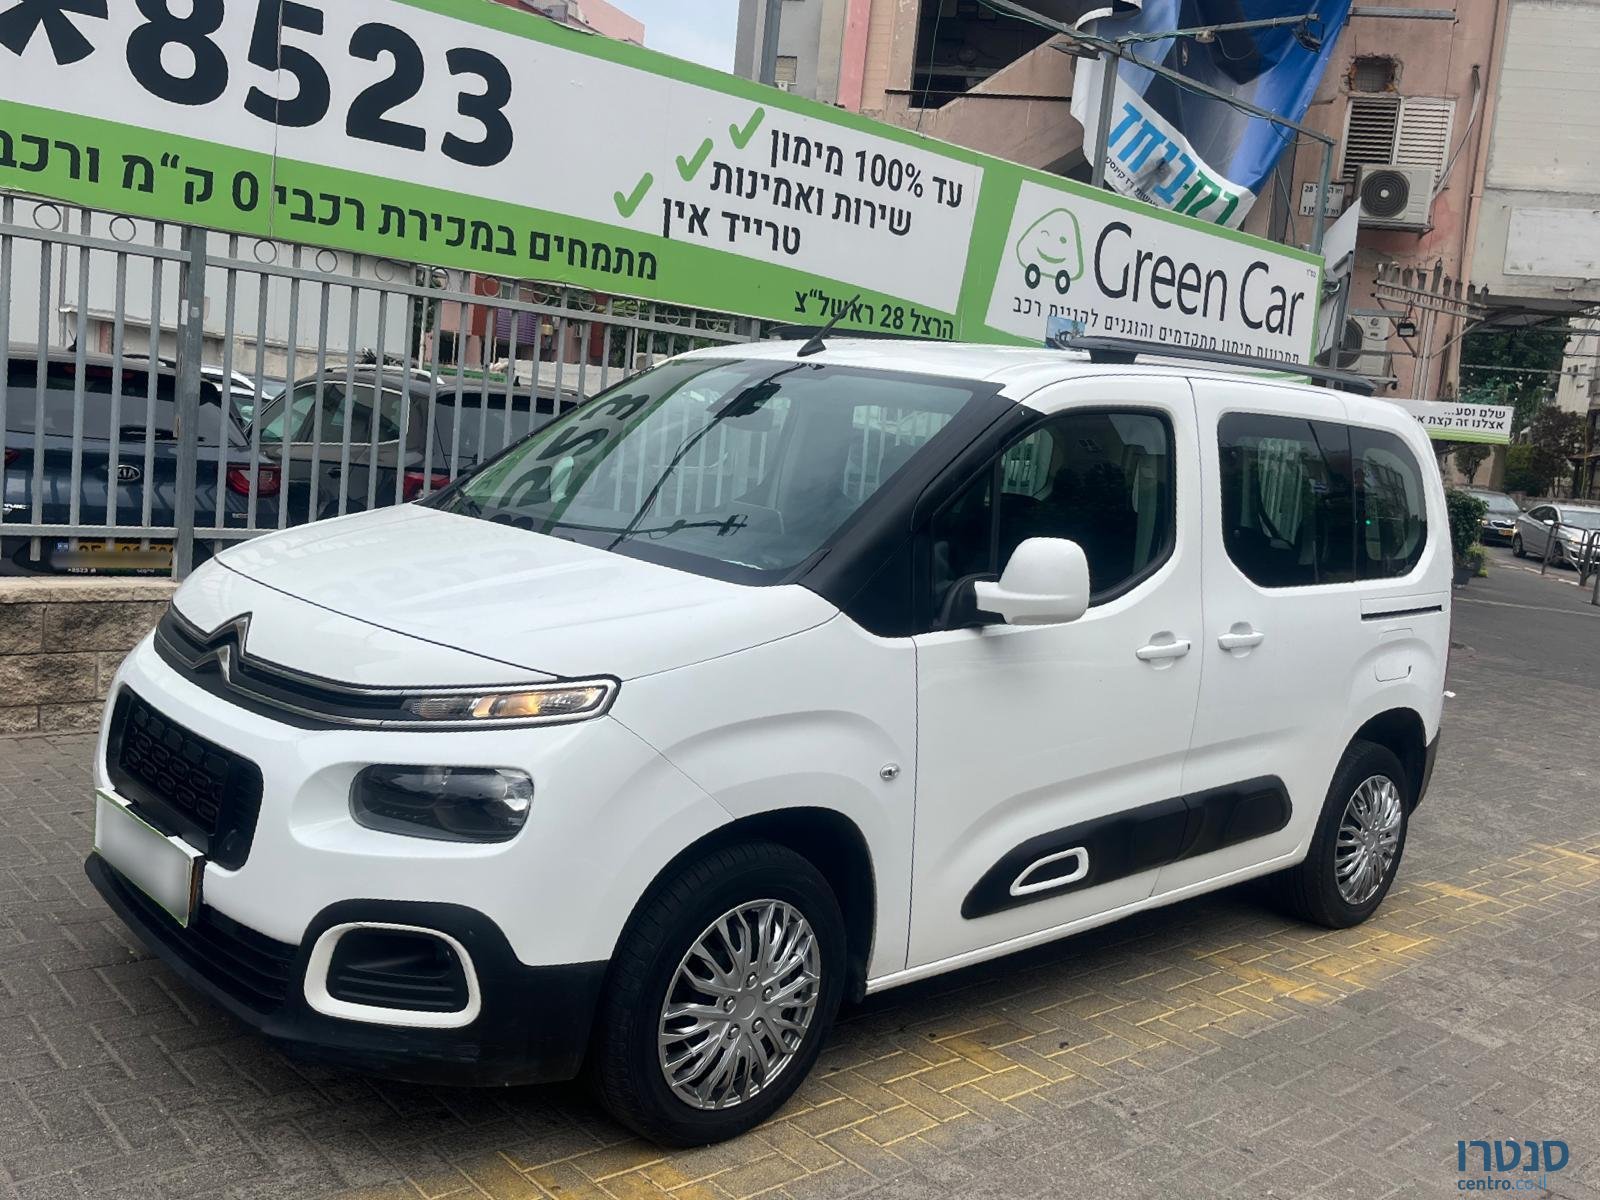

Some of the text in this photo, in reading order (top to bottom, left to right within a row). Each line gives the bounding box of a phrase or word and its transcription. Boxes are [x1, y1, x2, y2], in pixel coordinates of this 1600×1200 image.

[770, 129, 963, 208] עד 100% מימון
[231, 170, 259, 212] 0
[274, 184, 365, 232] רכבי
[709, 161, 912, 236] שירות ואמינות
[377, 203, 518, 256] במכירת
[662, 198, 801, 255] טרייד אין
[529, 230, 657, 281] מתמחים
[1093, 221, 1305, 337] Green Car
[879, 303, 905, 330] 28
[910, 307, 954, 340] הרצל
[1012, 296, 1042, 317] רכב
[1104, 315, 1154, 338] והוגנים
[1428, 416, 1453, 428] קצת
[1455, 418, 1470, 427] זה
[1472, 418, 1505, 430] אצלנו
[1479, 408, 1506, 419] שלם
